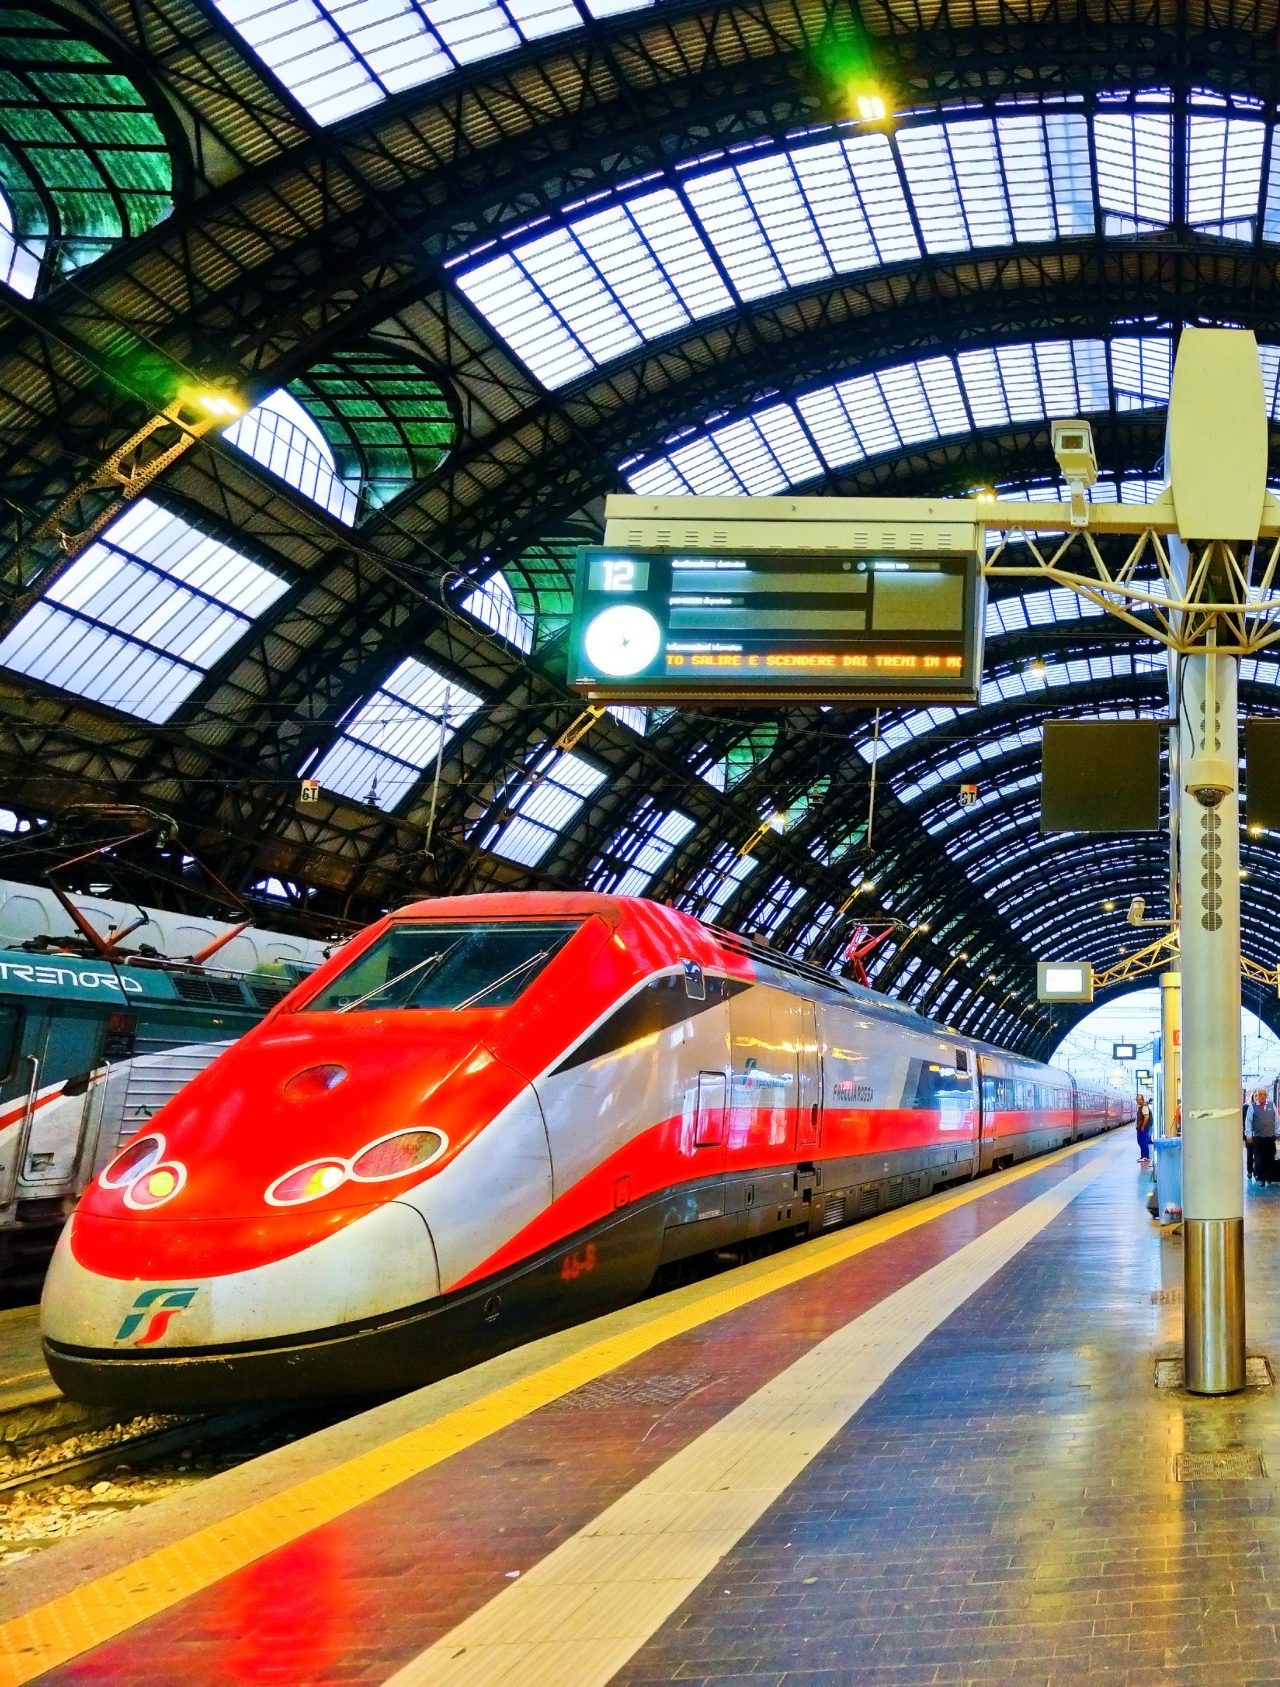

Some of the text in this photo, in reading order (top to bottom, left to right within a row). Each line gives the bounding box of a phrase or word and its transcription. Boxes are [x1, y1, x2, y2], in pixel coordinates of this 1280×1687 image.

[602, 561, 634, 590] 12
[667, 655, 684, 665] TO
[691, 655, 742, 666] SALIRE
[748, 655, 759, 666] E
[766, 655, 836, 666] SCENDERE
[843, 655, 868, 667] DAI
[875, 656, 917, 667] TRENI
[0, 962, 143, 993] TRENORD
